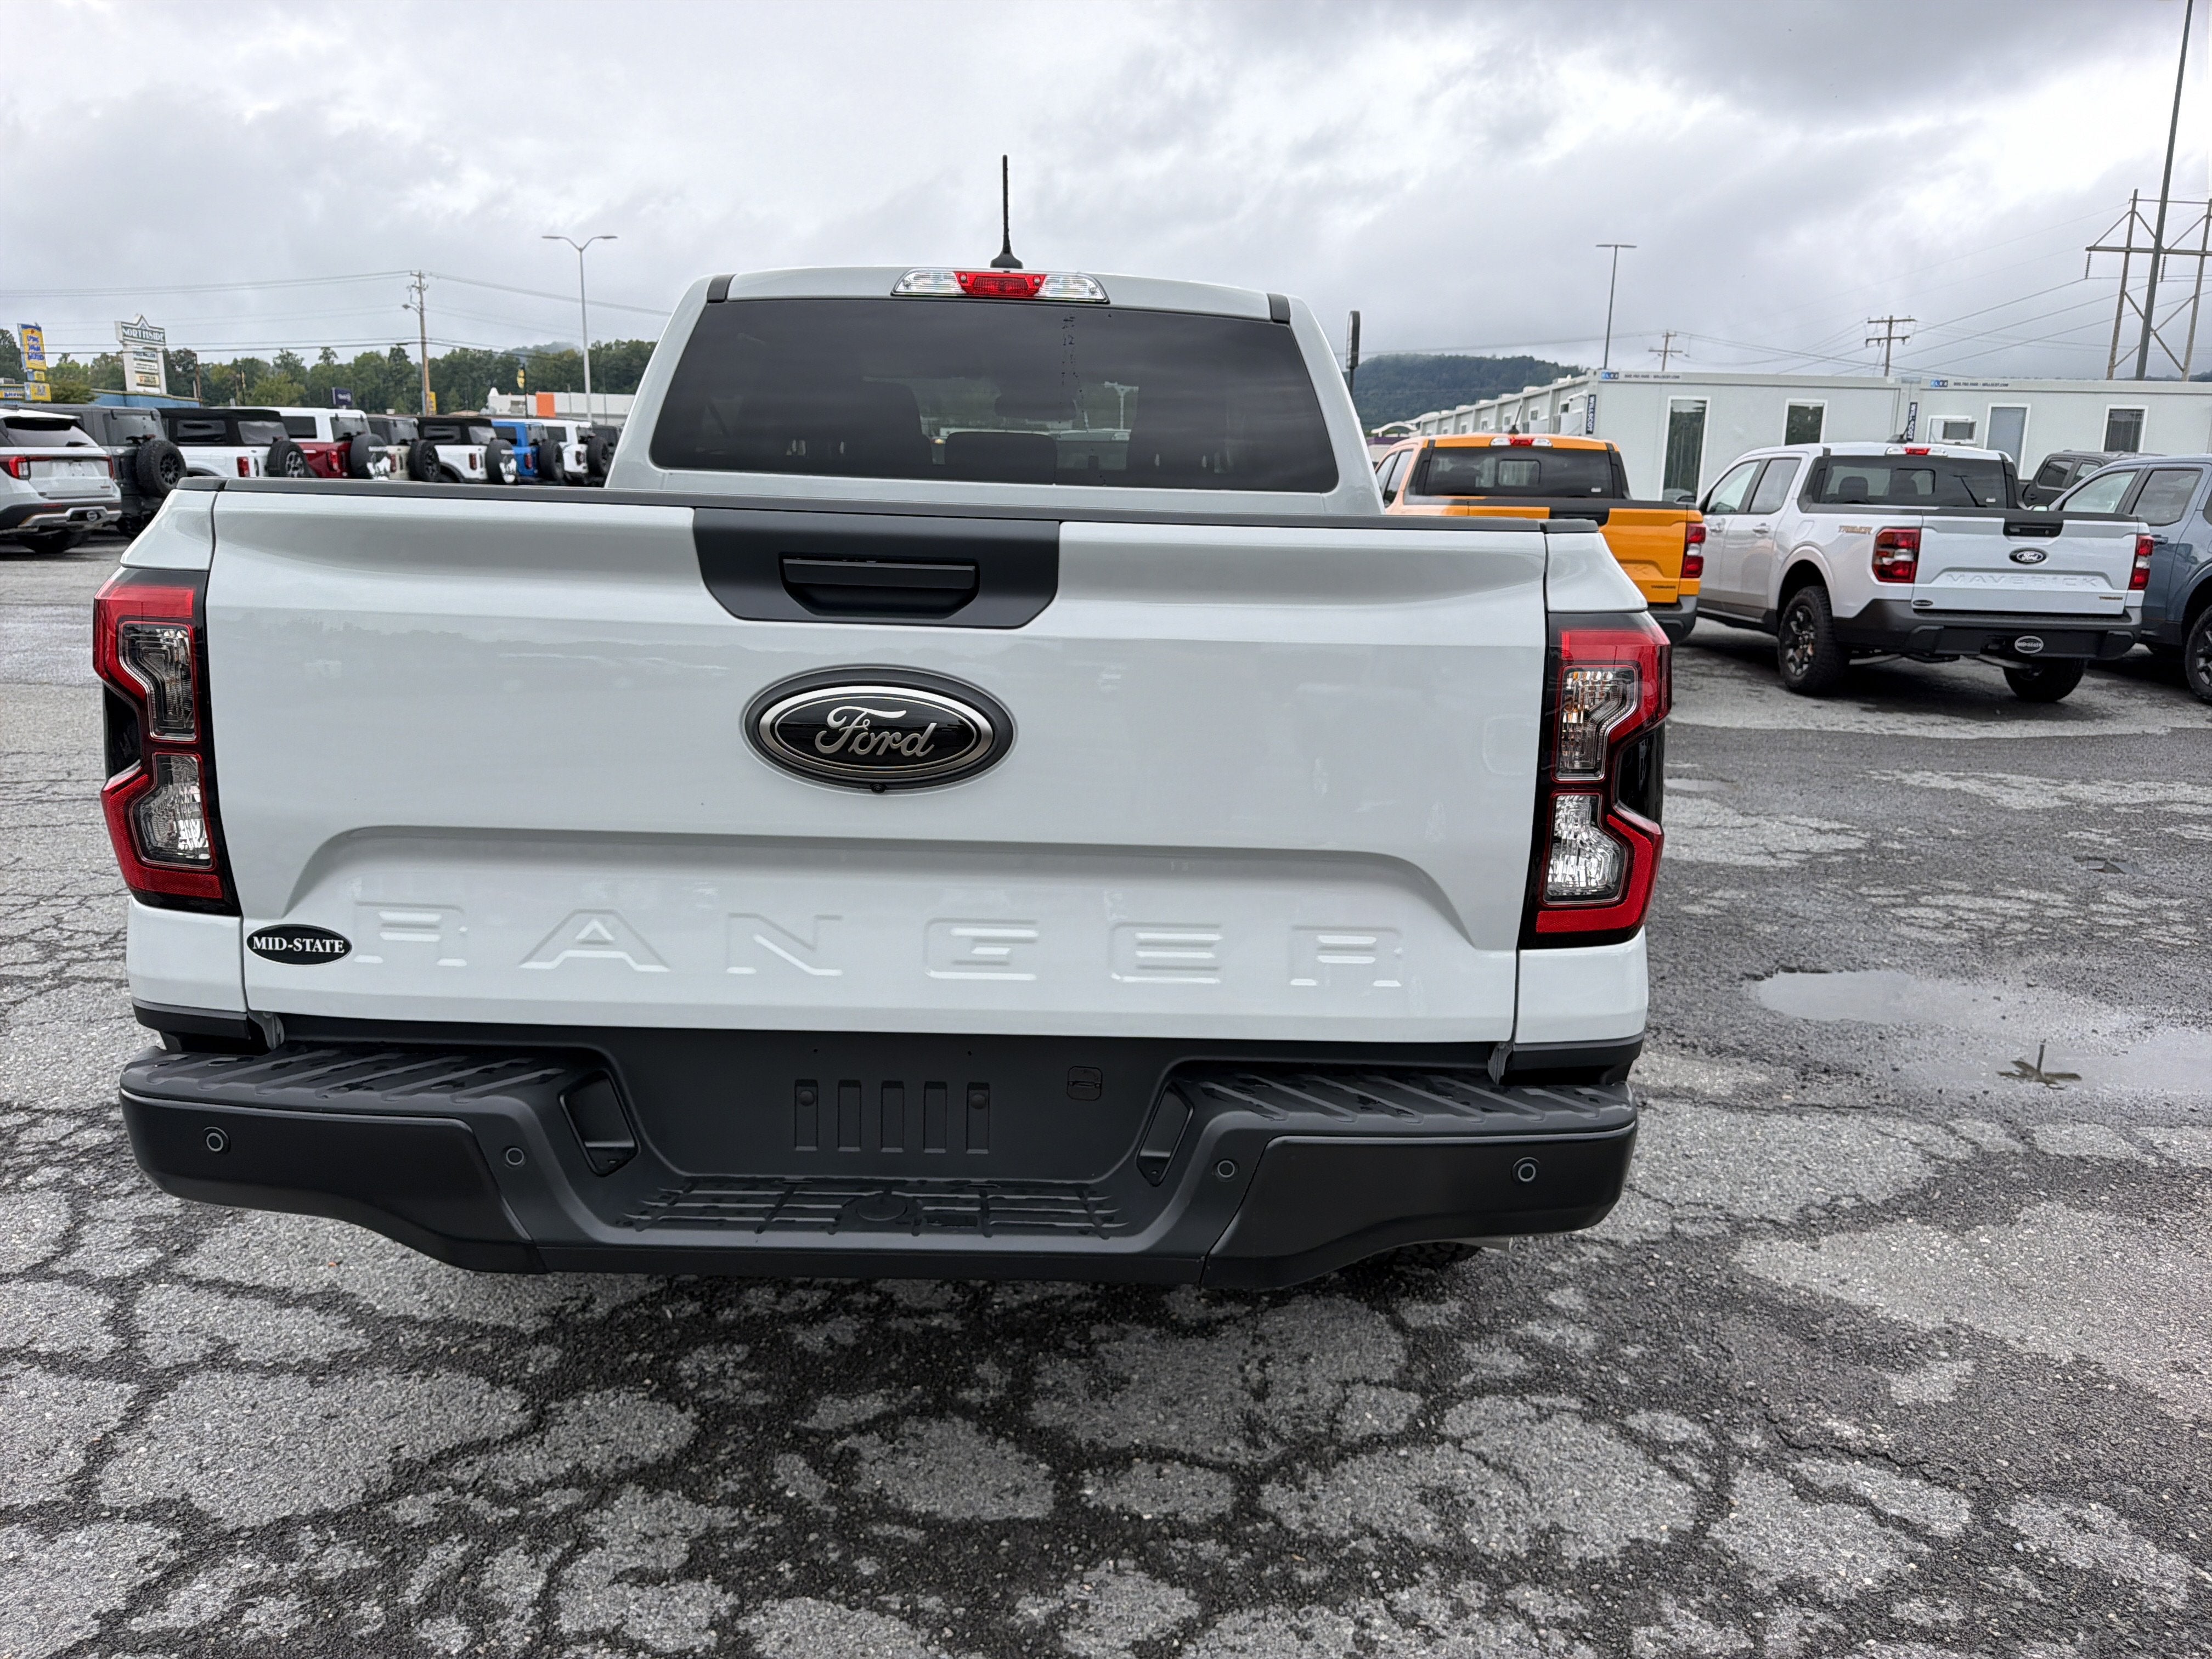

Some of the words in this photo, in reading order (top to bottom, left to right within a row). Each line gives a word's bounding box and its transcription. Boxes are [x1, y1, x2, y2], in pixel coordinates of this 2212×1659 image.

[122, 328, 165, 341] NORTHSIDE
[1948, 574, 2098, 588] MAVERICK
[814, 705, 938, 758] Ford
[252, 935, 345, 954] MID-STATE
[353, 900, 1403, 987] RANGER
